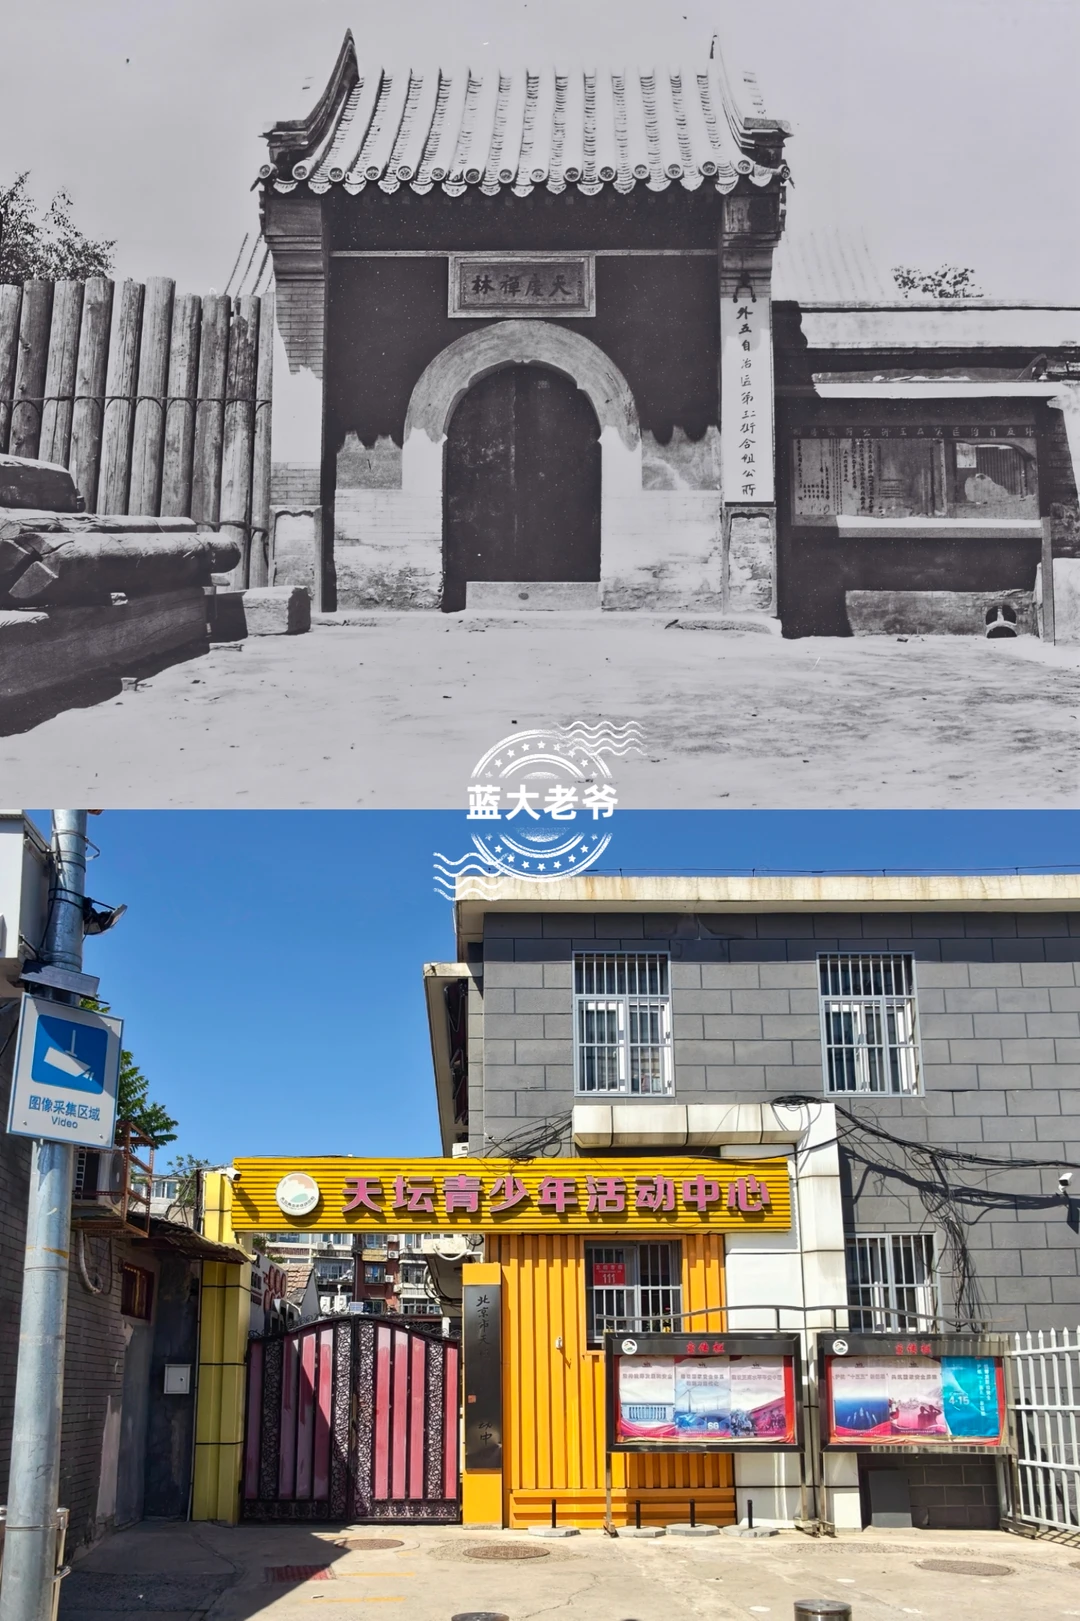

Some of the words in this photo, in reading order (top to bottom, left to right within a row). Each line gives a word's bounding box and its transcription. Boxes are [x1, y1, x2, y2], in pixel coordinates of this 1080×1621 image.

[28, 1095, 100, 1121] 图像采集区域
[51, 1115, 78, 1129] Video
[341, 1174, 772, 1214] 天坛青少年活动中心
[602, 1273, 616, 1284] 111
